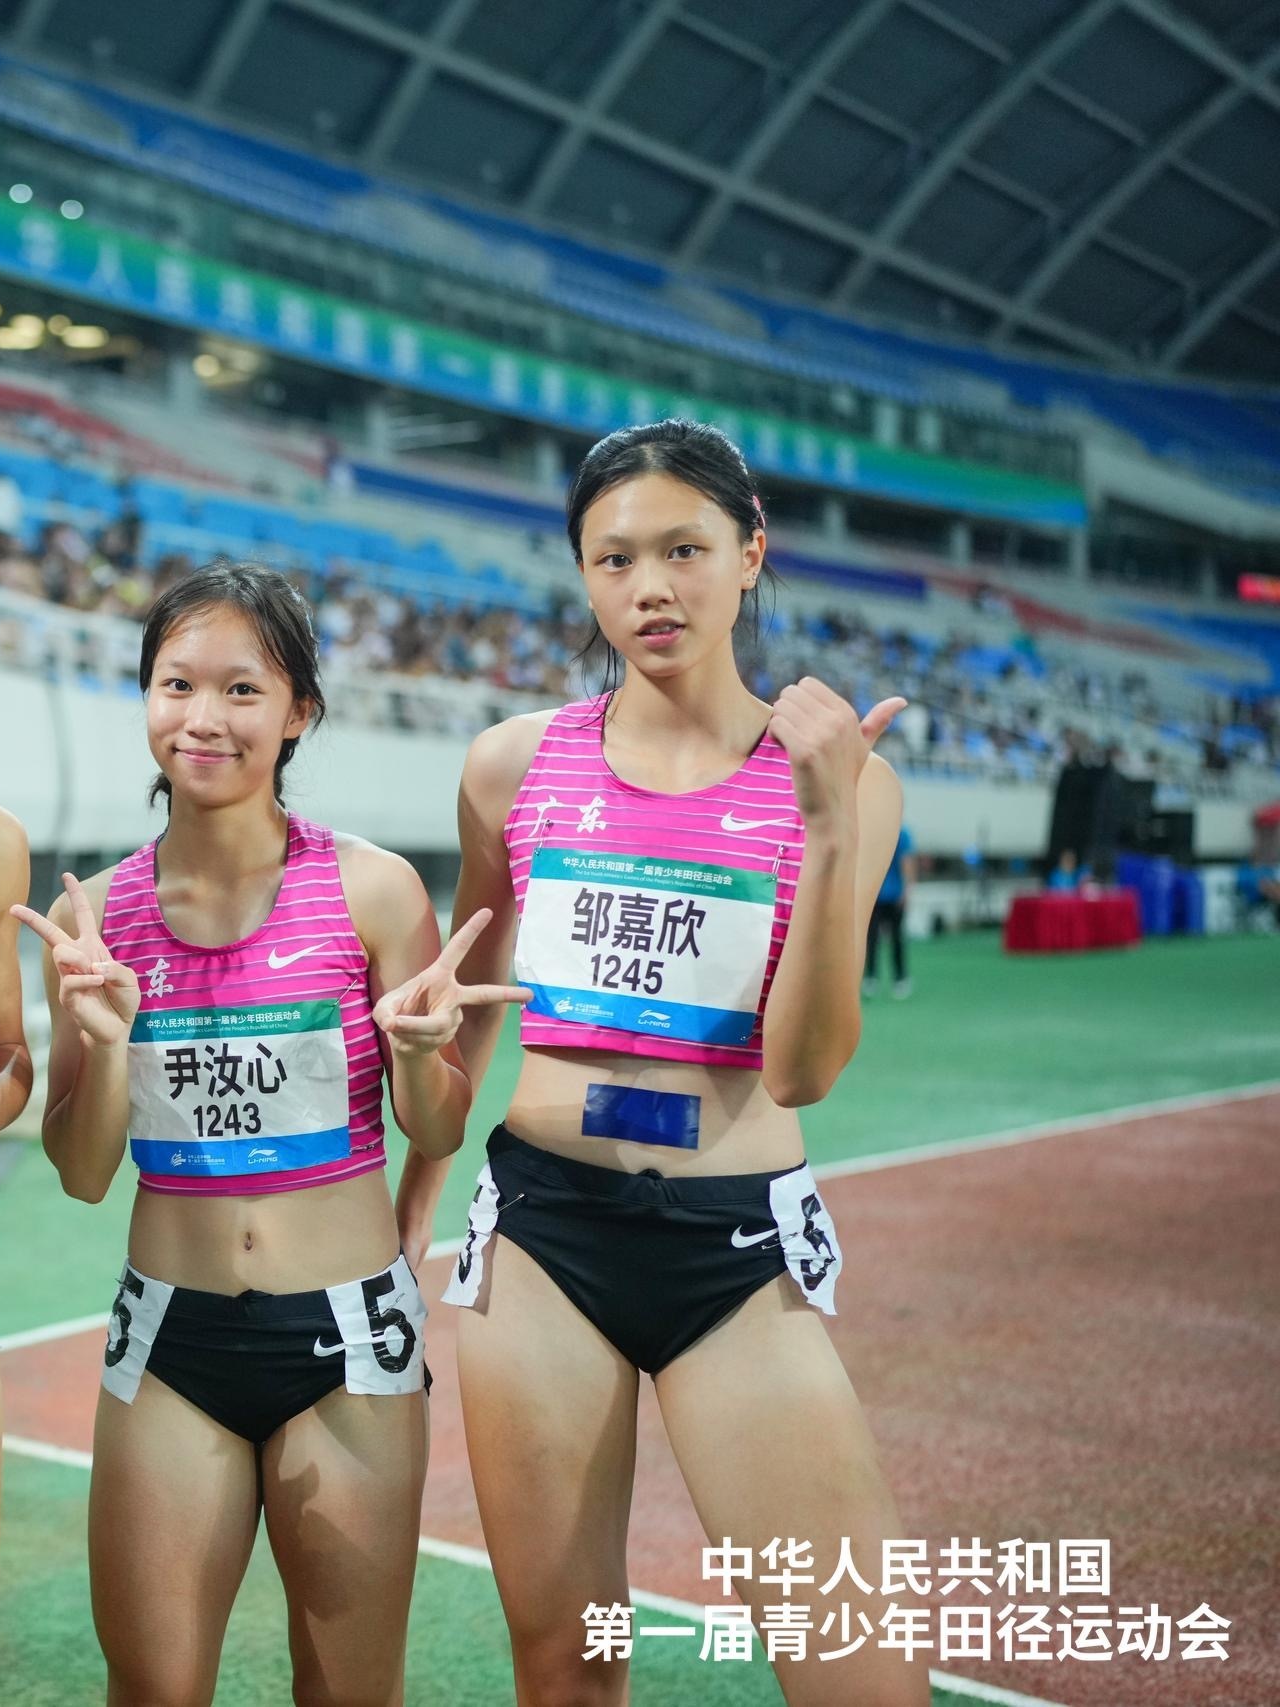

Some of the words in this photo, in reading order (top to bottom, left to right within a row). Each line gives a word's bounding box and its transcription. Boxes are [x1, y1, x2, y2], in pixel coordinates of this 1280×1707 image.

[528, 795, 607, 838] 广东
[562, 857, 733, 885] 中华人民共和国第一届青少年田径运动会
[571, 887, 706, 958] 邹嘉欣
[590, 953, 664, 995] 1245
[147, 1010, 301, 1029] 中华人民共和国第一届青少年田径运动会
[164, 1042, 288, 1100] 尹汝心
[193, 1102, 262, 1138] 1243
[361, 1270, 416, 1374] 5
